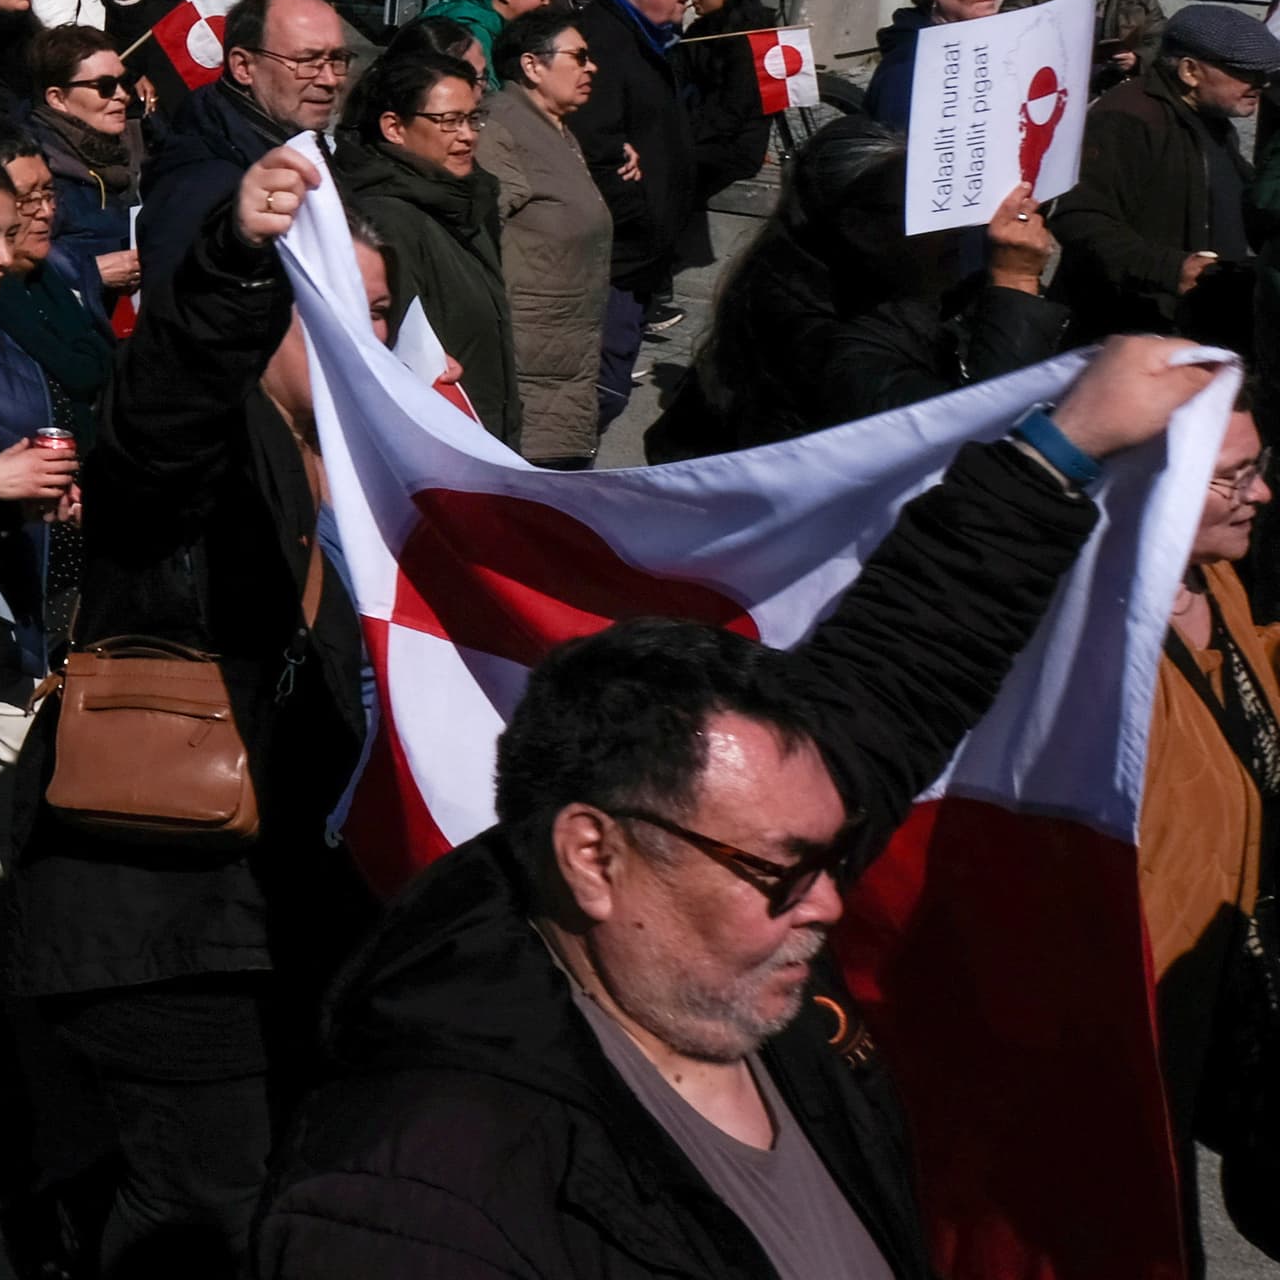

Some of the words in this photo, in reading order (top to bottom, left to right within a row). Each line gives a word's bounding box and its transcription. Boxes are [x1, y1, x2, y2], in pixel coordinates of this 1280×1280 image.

[941, 40, 961, 119] nunaat
[968, 43, 993, 114] pigaat
[930, 125, 956, 214] Kalaallit
[962, 121, 987, 208] Kalaallit
